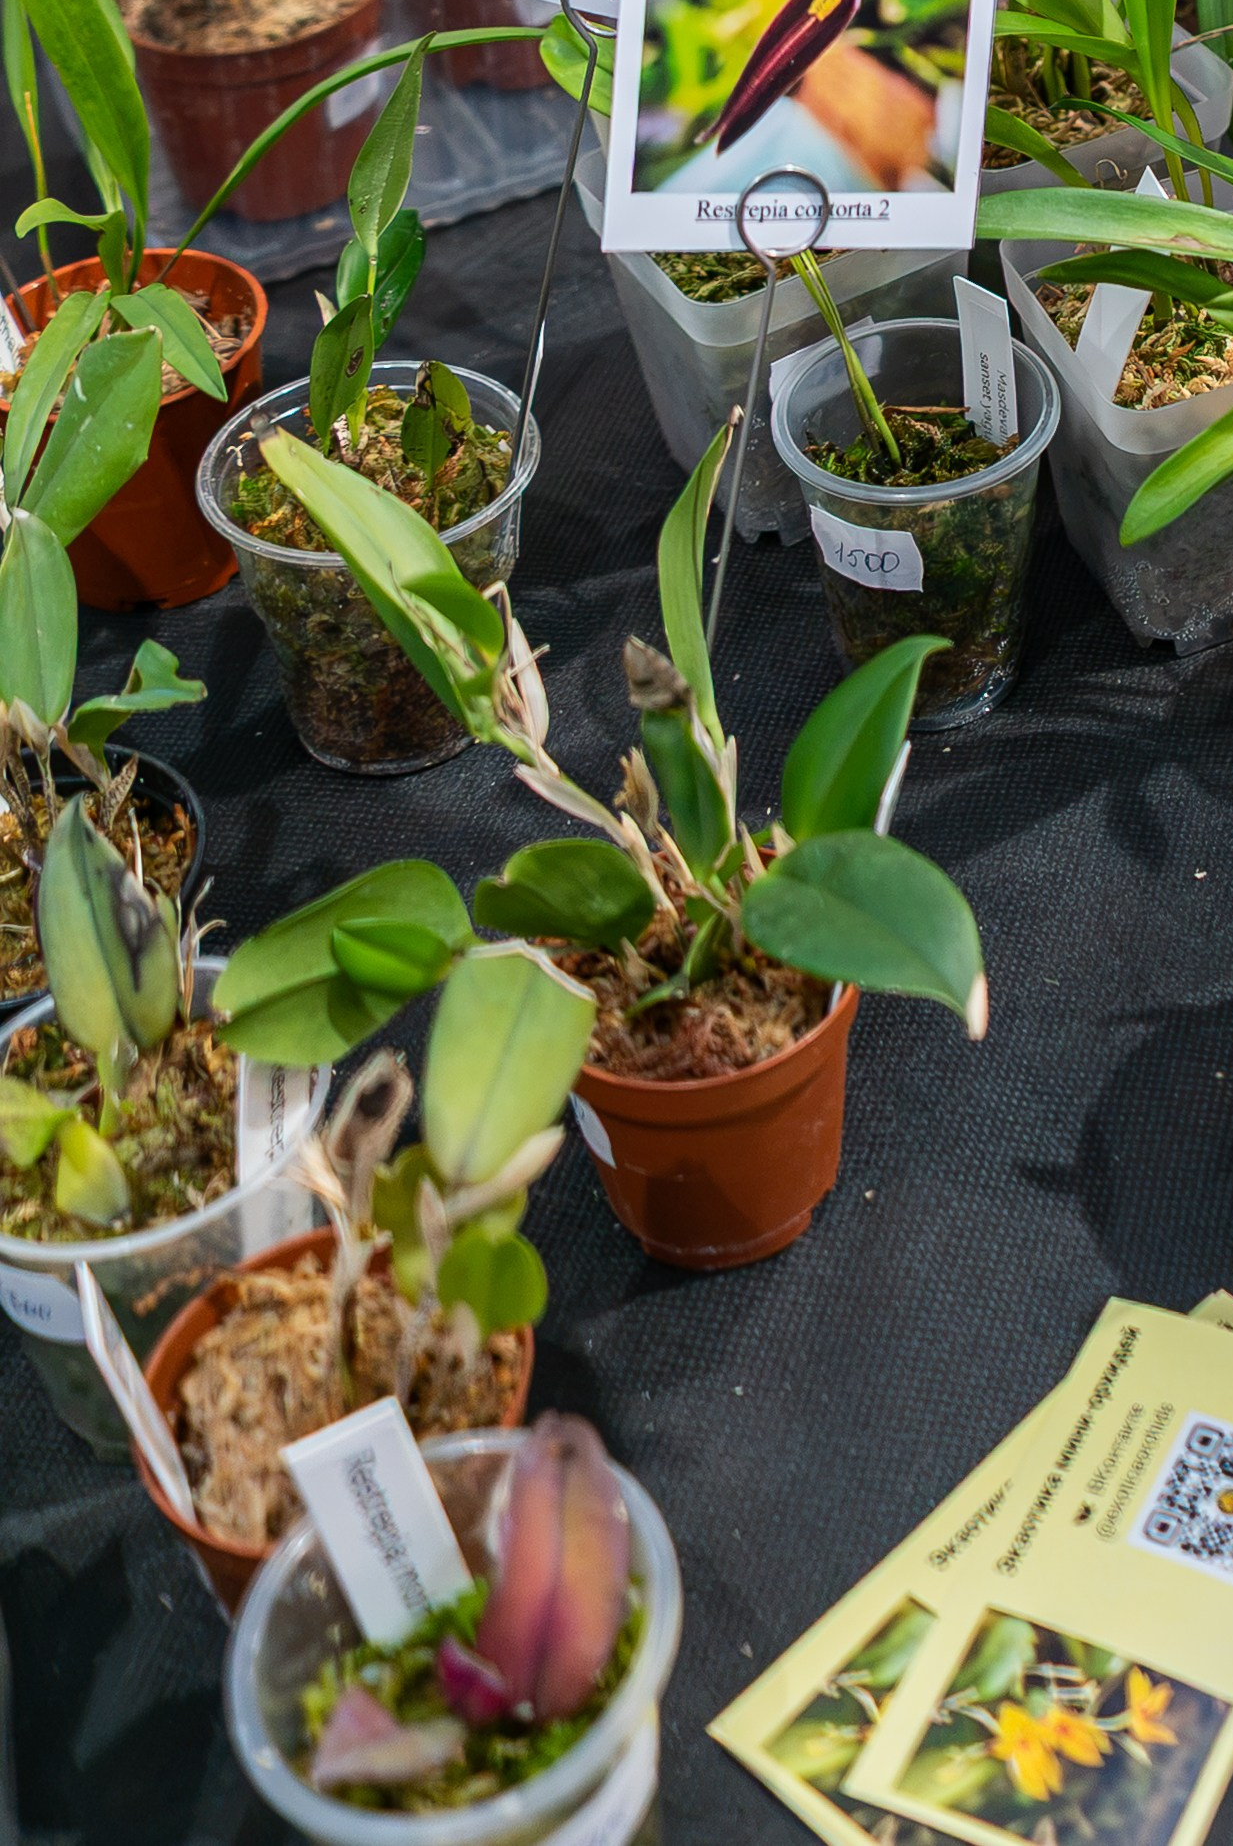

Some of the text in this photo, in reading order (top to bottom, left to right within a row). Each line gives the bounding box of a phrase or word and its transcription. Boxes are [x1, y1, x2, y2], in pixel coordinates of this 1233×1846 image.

[879, 199, 890, 217] 2
[997, 370, 1009, 444] Masdevall
[835, 542, 899, 573] 1500
[929, 1478, 1013, 1572] Экзотик
[995, 1472, 1062, 1577] Экзотика
